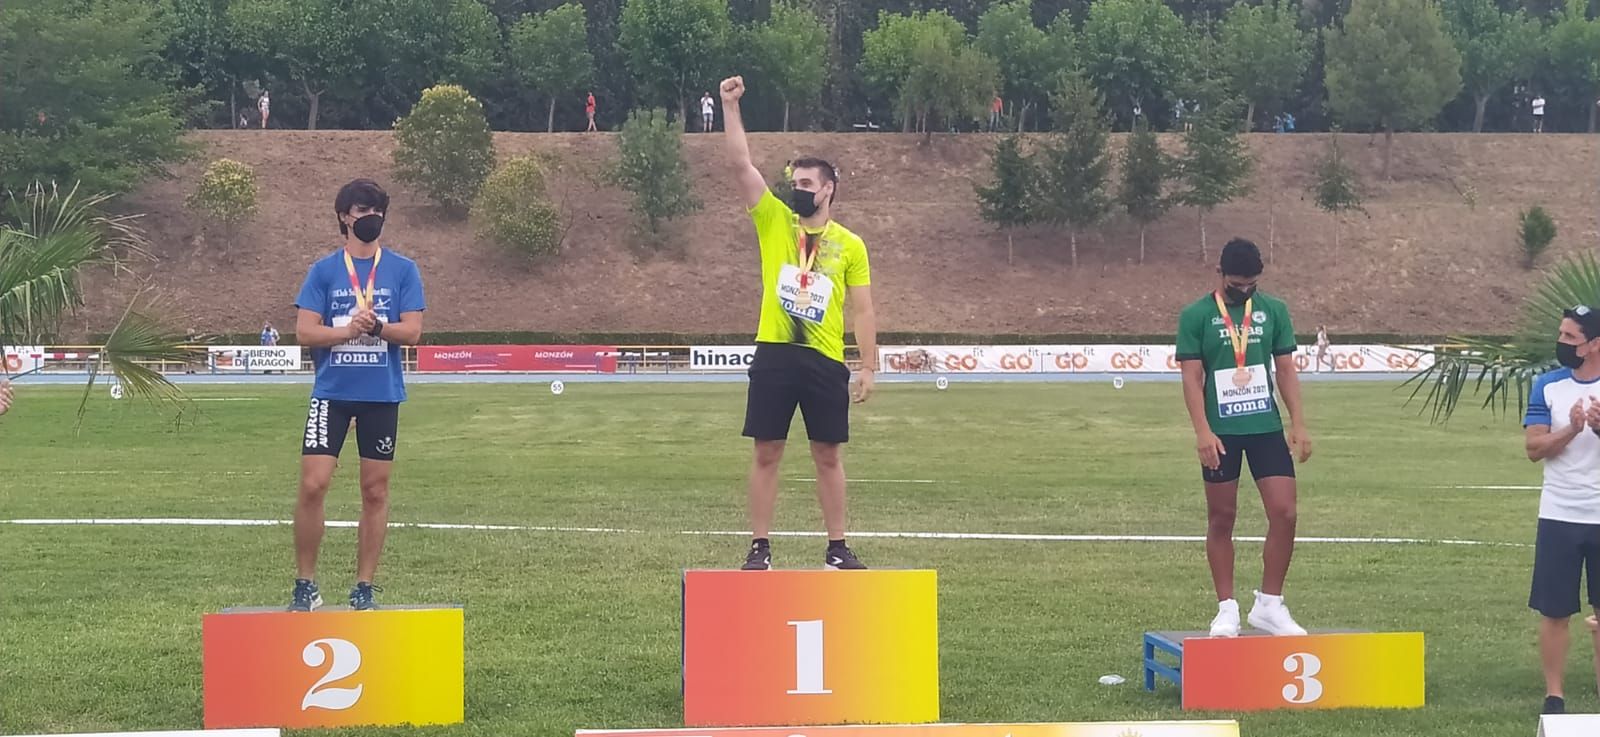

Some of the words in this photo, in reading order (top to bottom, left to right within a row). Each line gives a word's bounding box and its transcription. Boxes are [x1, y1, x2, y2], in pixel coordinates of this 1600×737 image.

[535, 350, 573, 359] MONZÓN
[944, 354, 978, 370] GO
[1000, 353, 1032, 370] GO
[1055, 353, 1088, 370] GO
[1111, 352, 1143, 369] GO
[786, 620, 832, 693] 1
[302, 638, 363, 710] 2
[1281, 653, 1323, 703] 3
